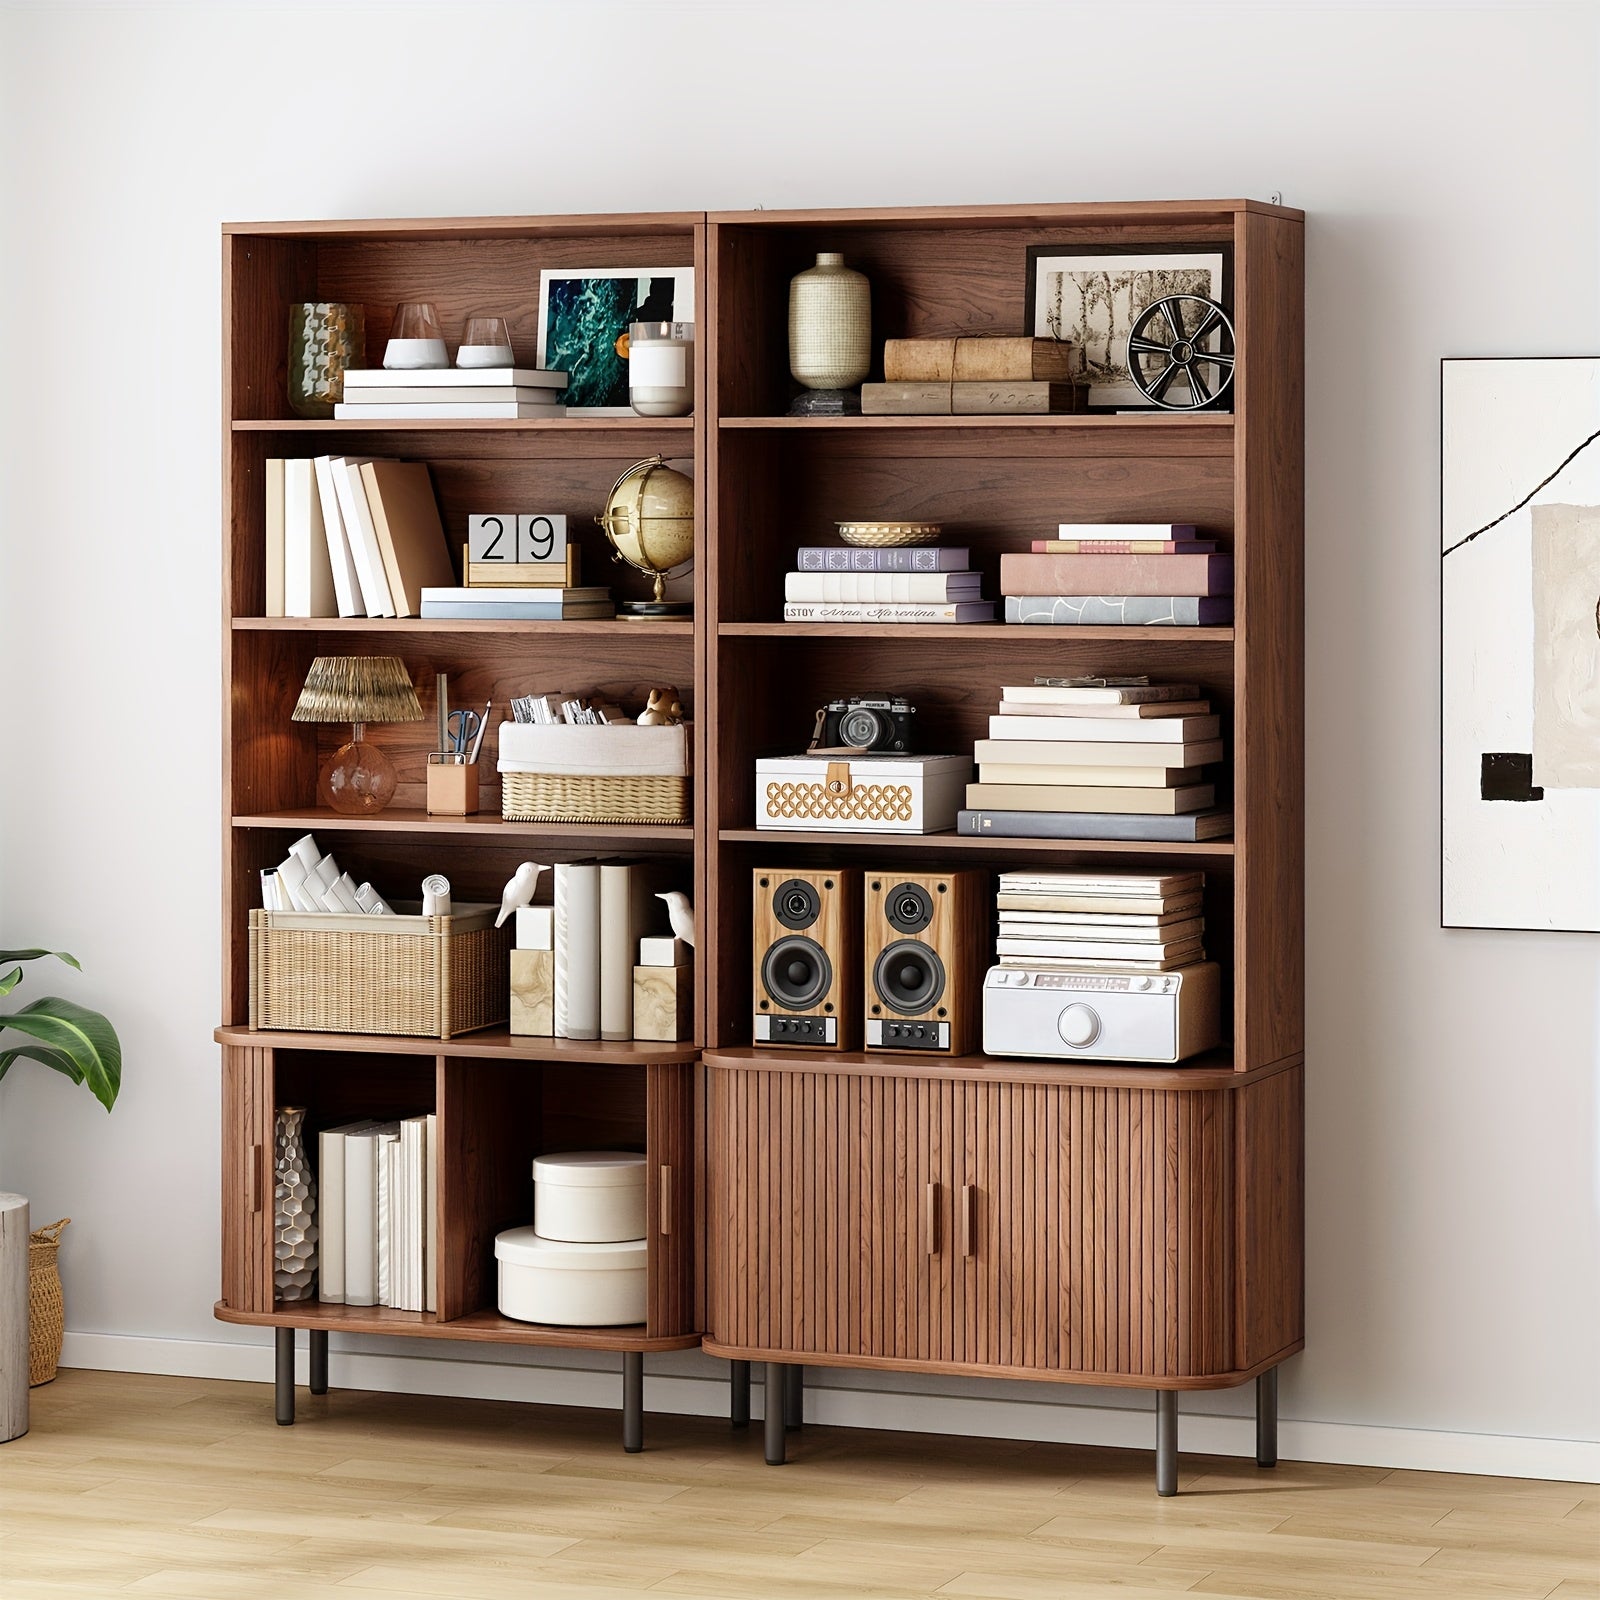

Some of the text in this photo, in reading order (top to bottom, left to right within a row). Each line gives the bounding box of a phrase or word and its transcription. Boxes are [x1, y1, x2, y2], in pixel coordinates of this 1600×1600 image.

[481, 516, 555, 560] 29
[785, 608, 936, 619] LSTOY Anna Karenina
